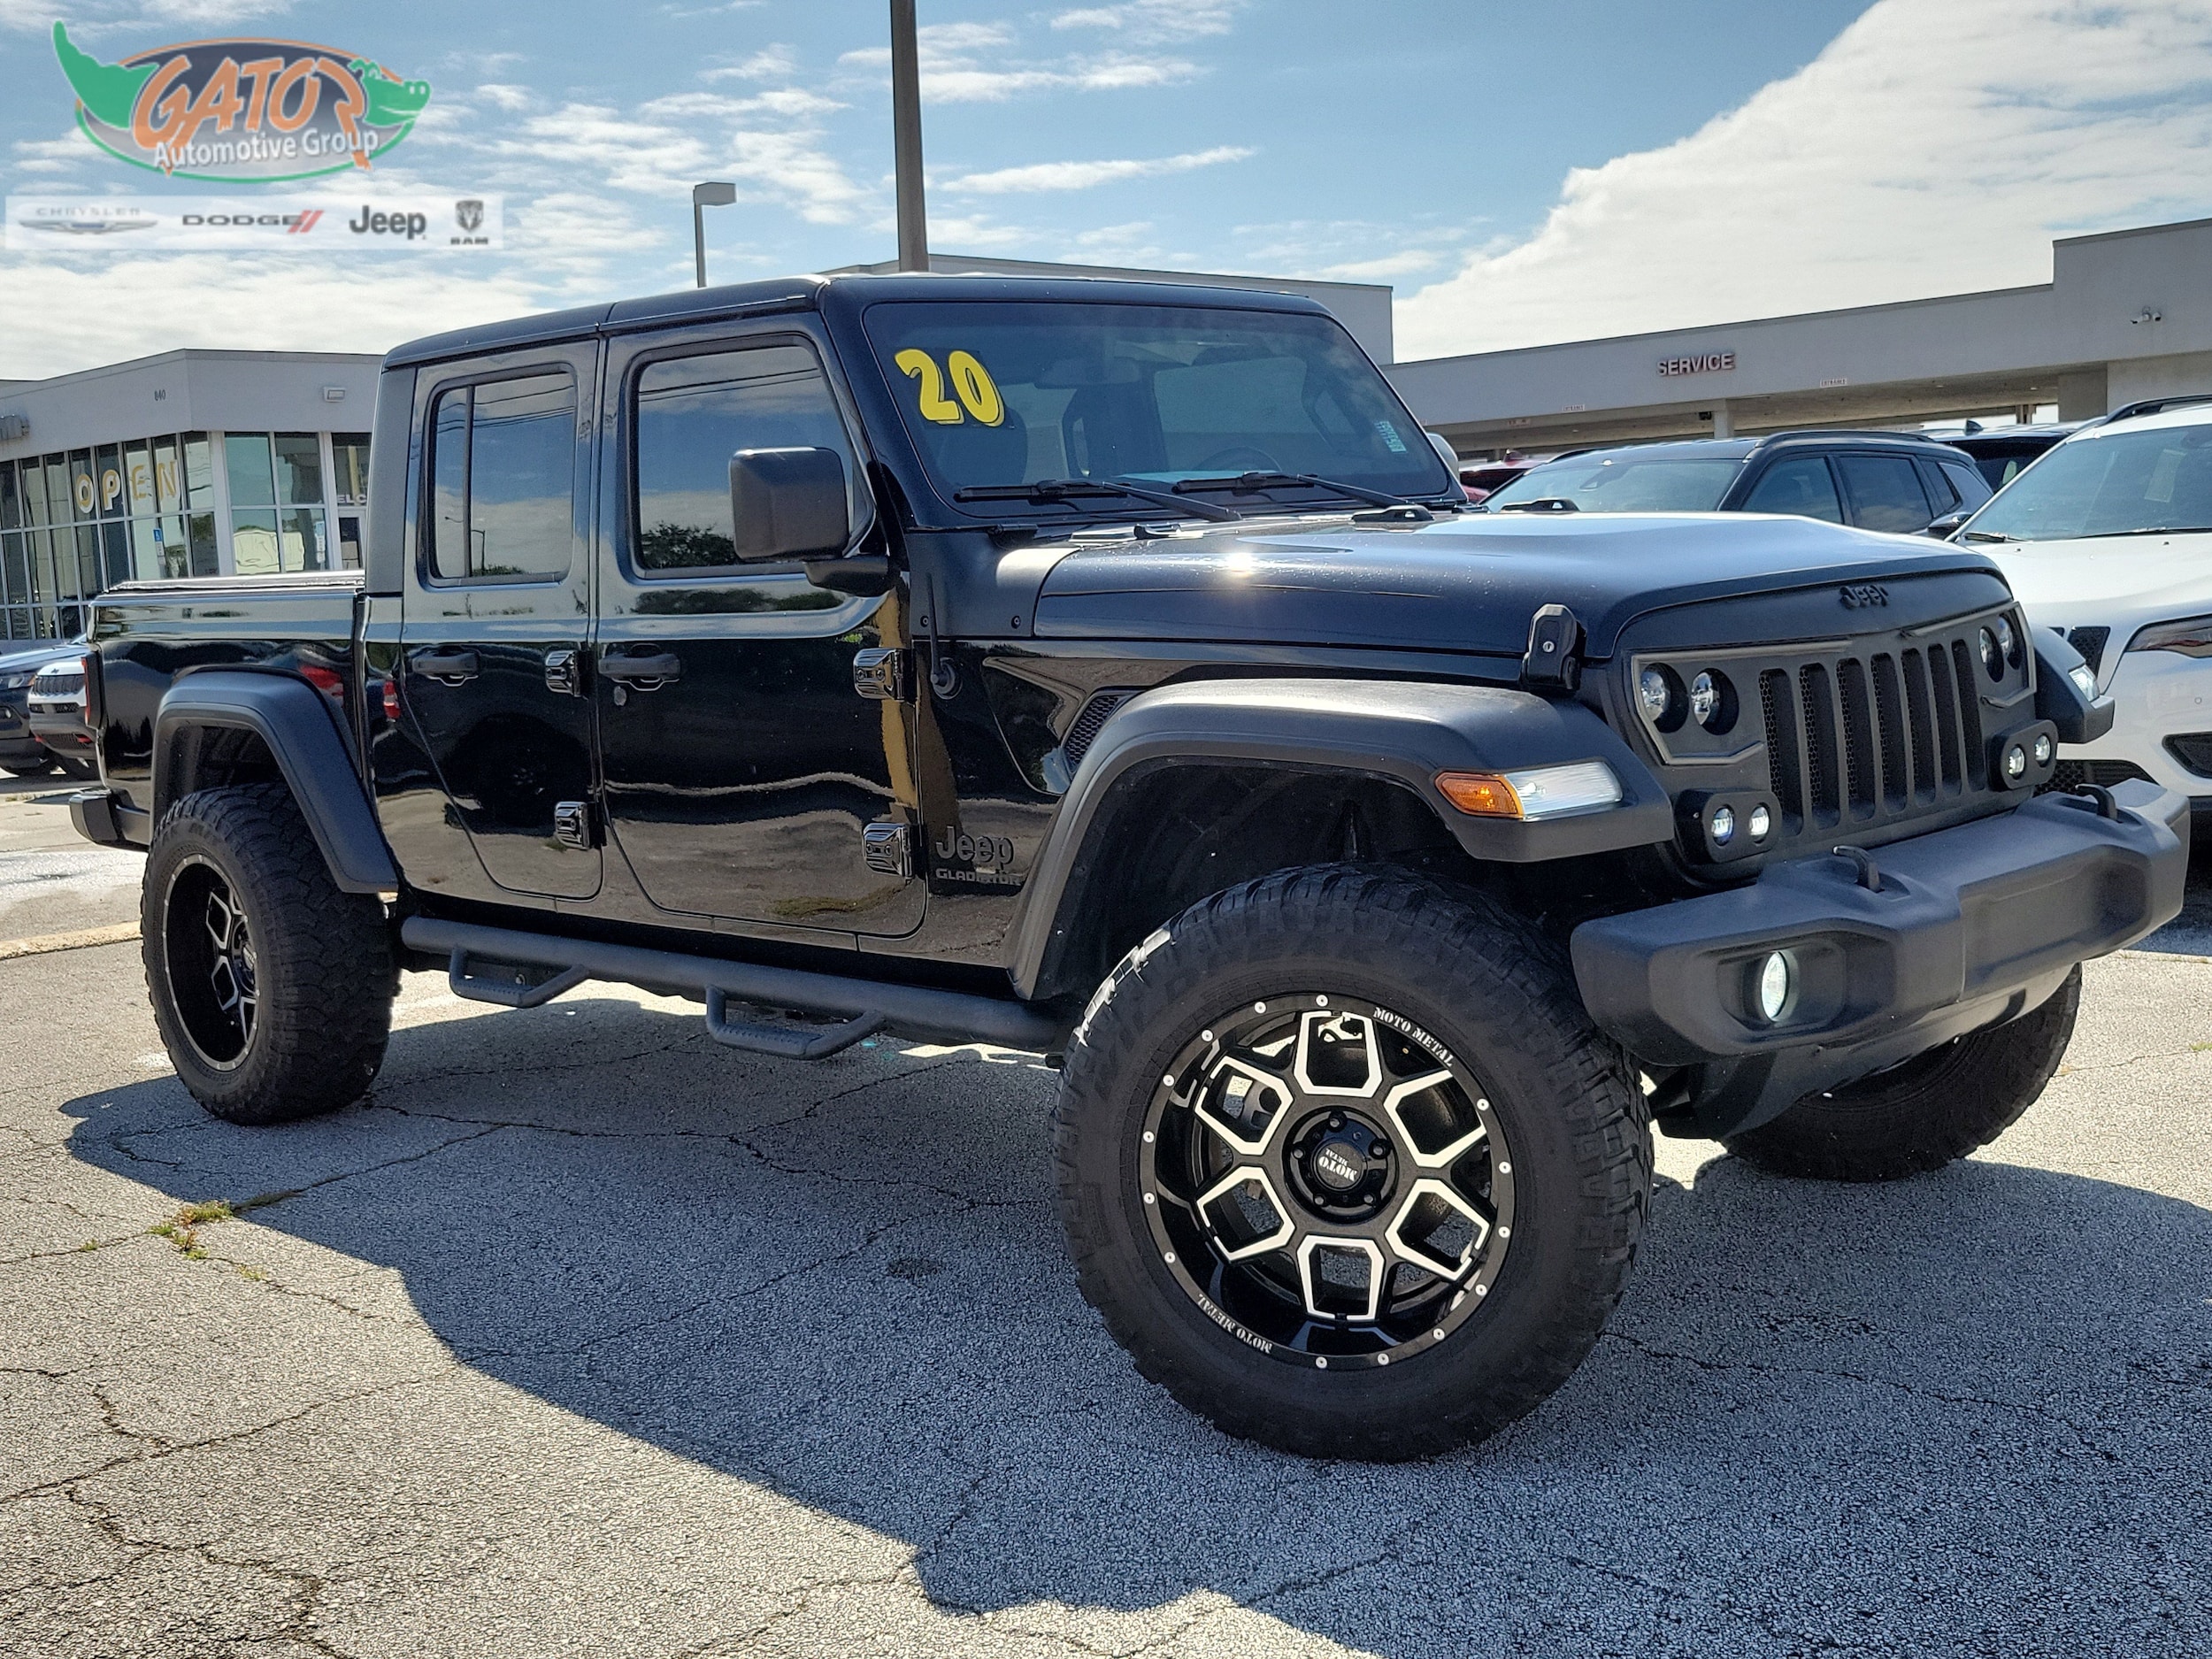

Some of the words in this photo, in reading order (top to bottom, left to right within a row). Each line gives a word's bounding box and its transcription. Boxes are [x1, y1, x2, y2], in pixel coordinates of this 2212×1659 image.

[1656, 352, 1736, 377] SERVICE
[894, 348, 1005, 427] 20
[75, 459, 181, 514] OPEN
[337, 494, 367, 504] ELC
[1839, 584, 1890, 611] Jeep
[935, 826, 1014, 871] Jeep
[1372, 1006, 1412, 1033] MOTO
[1411, 1026, 1455, 1068] METAL
[1317, 1156, 1358, 1182] MOTO
[1197, 1294, 1236, 1333] METAL
[1236, 1327, 1273, 1354] MOTO
